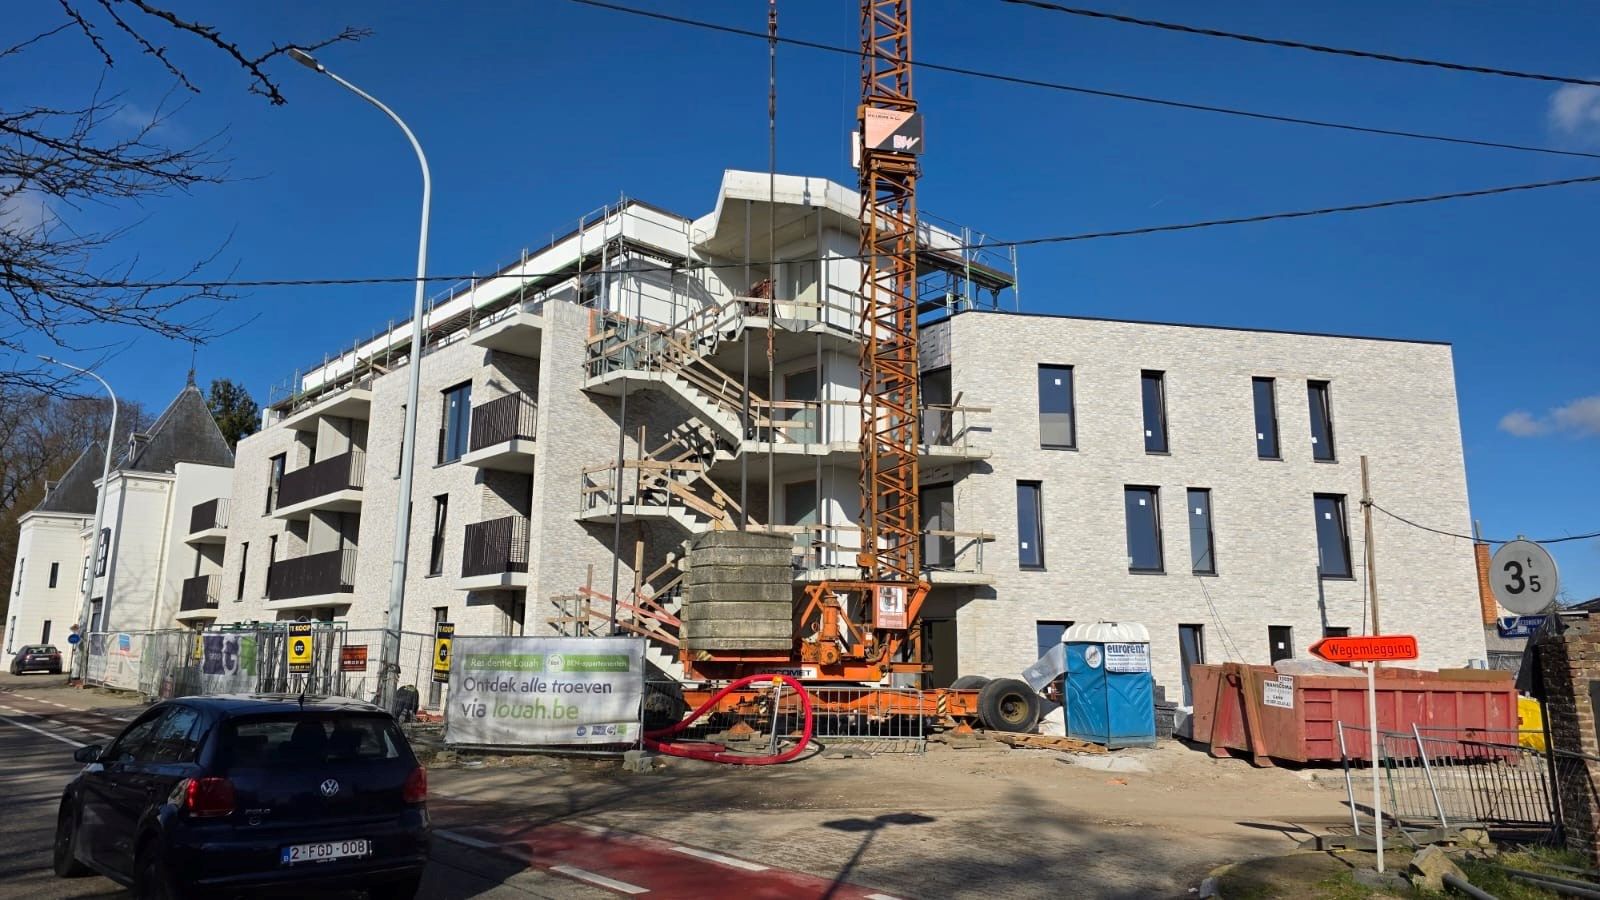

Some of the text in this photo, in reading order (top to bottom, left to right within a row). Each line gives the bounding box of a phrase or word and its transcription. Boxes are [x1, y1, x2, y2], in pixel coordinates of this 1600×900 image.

[1503, 560, 1525, 595] 3
[1529, 575, 1541, 593] 5
[1107, 644, 1145, 654] eurorent
[1328, 643, 1411, 657] Wegomlegging
[513, 658, 539, 668] Louah
[463, 677, 612, 694] Ontdek alle troeven
[462, 697, 579, 720] via louah.be
